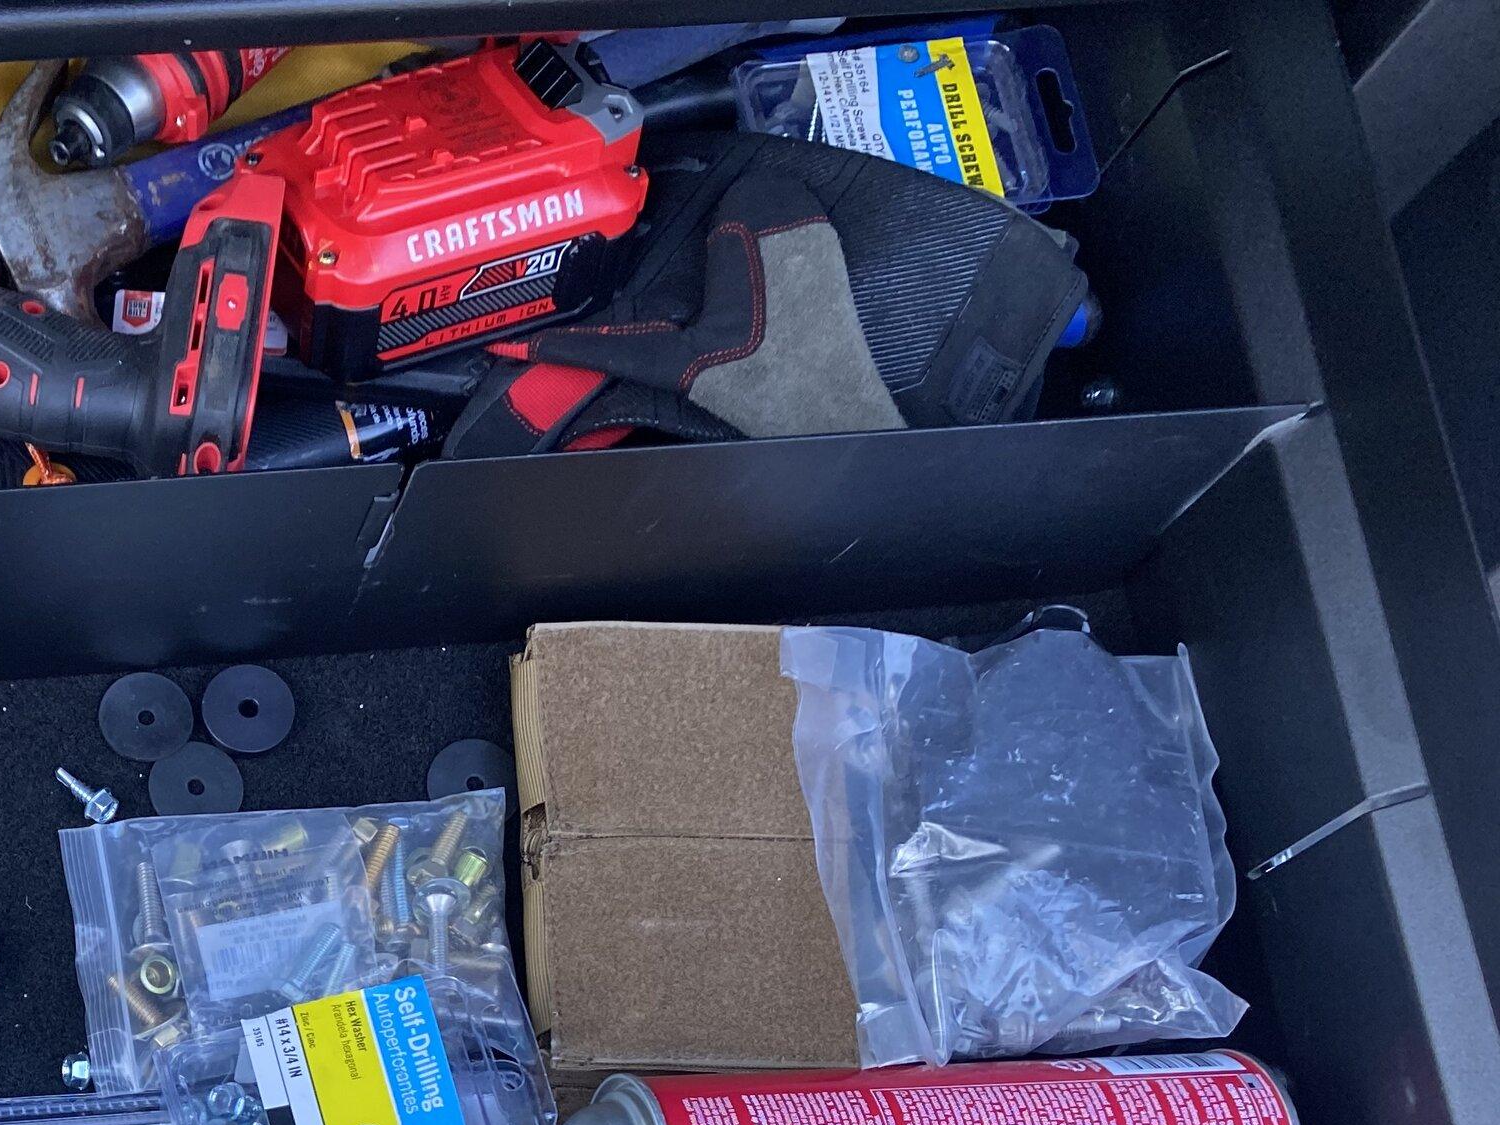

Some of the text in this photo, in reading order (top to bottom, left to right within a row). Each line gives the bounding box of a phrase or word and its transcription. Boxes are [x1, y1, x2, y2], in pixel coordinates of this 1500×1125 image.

[836, 49, 851, 71] Self
[854, 62, 869, 93] 35164
[841, 70, 861, 107] Drilling
[852, 107, 868, 140] Screw
[871, 132, 885, 155] QTY
[896, 86, 934, 178] PERFORAN
[925, 120, 951, 166] AUTO
[941, 80, 984, 189] DRILL SCREW
[407, 189, 584, 262] CRAFTSMAN
[516, 250, 557, 277] V20
[389, 287, 437, 320] 4.0
[424, 302, 549, 346] LITHIUM ION
[252, 1026, 264, 1047] 35165
[274, 1016, 302, 1079] #14 x 3/4 IN
[330, 1003, 361, 1081] Arandela hexagonal
[345, 1000, 369, 1054] Hex Washer
[392, 983, 449, 1111] Self-Drilling
[371, 989, 421, 1116] Autoperforantes
